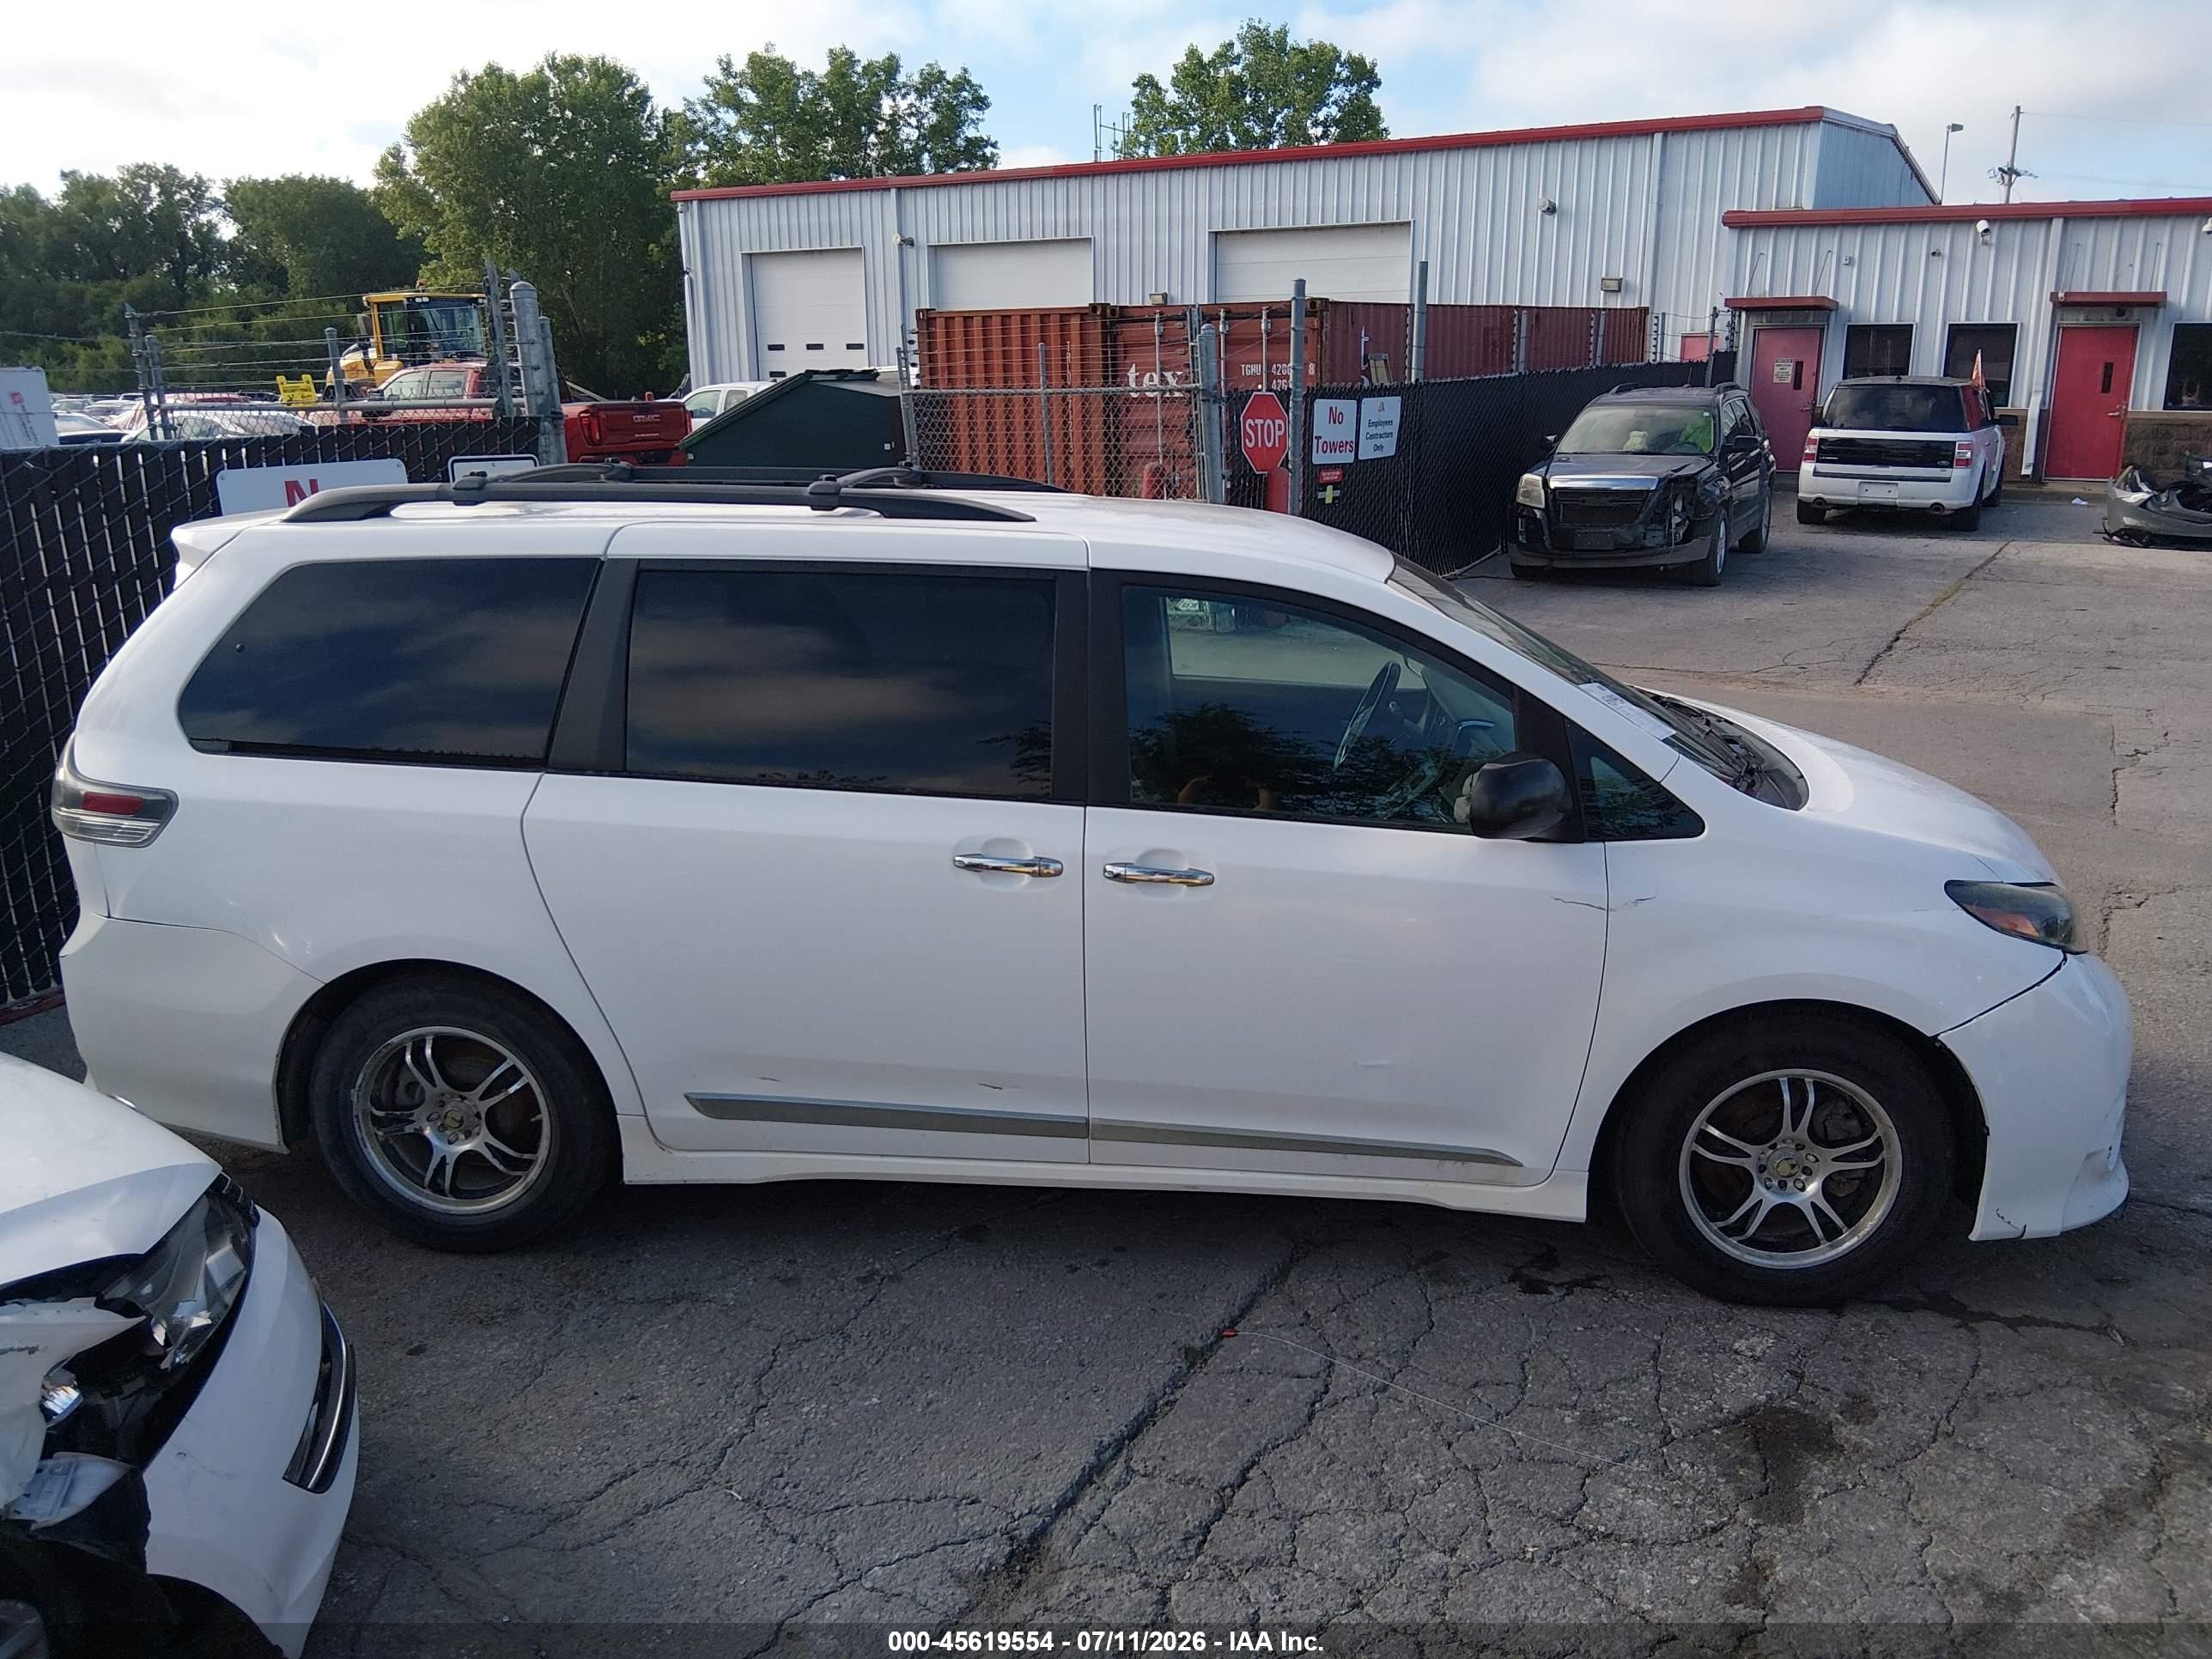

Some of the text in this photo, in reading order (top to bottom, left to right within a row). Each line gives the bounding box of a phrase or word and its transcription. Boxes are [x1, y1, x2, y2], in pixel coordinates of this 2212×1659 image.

[1240, 363, 1261, 376] TGHU
[1127, 363, 1184, 398] tex
[1328, 406, 1344, 425] No
[1368, 418, 1393, 429] Employees
[1245, 419, 1285, 448] STOP
[1365, 431, 1393, 441] Contractors
[1315, 435, 1354, 453] Towers
[1373, 443, 1384, 453] Only
